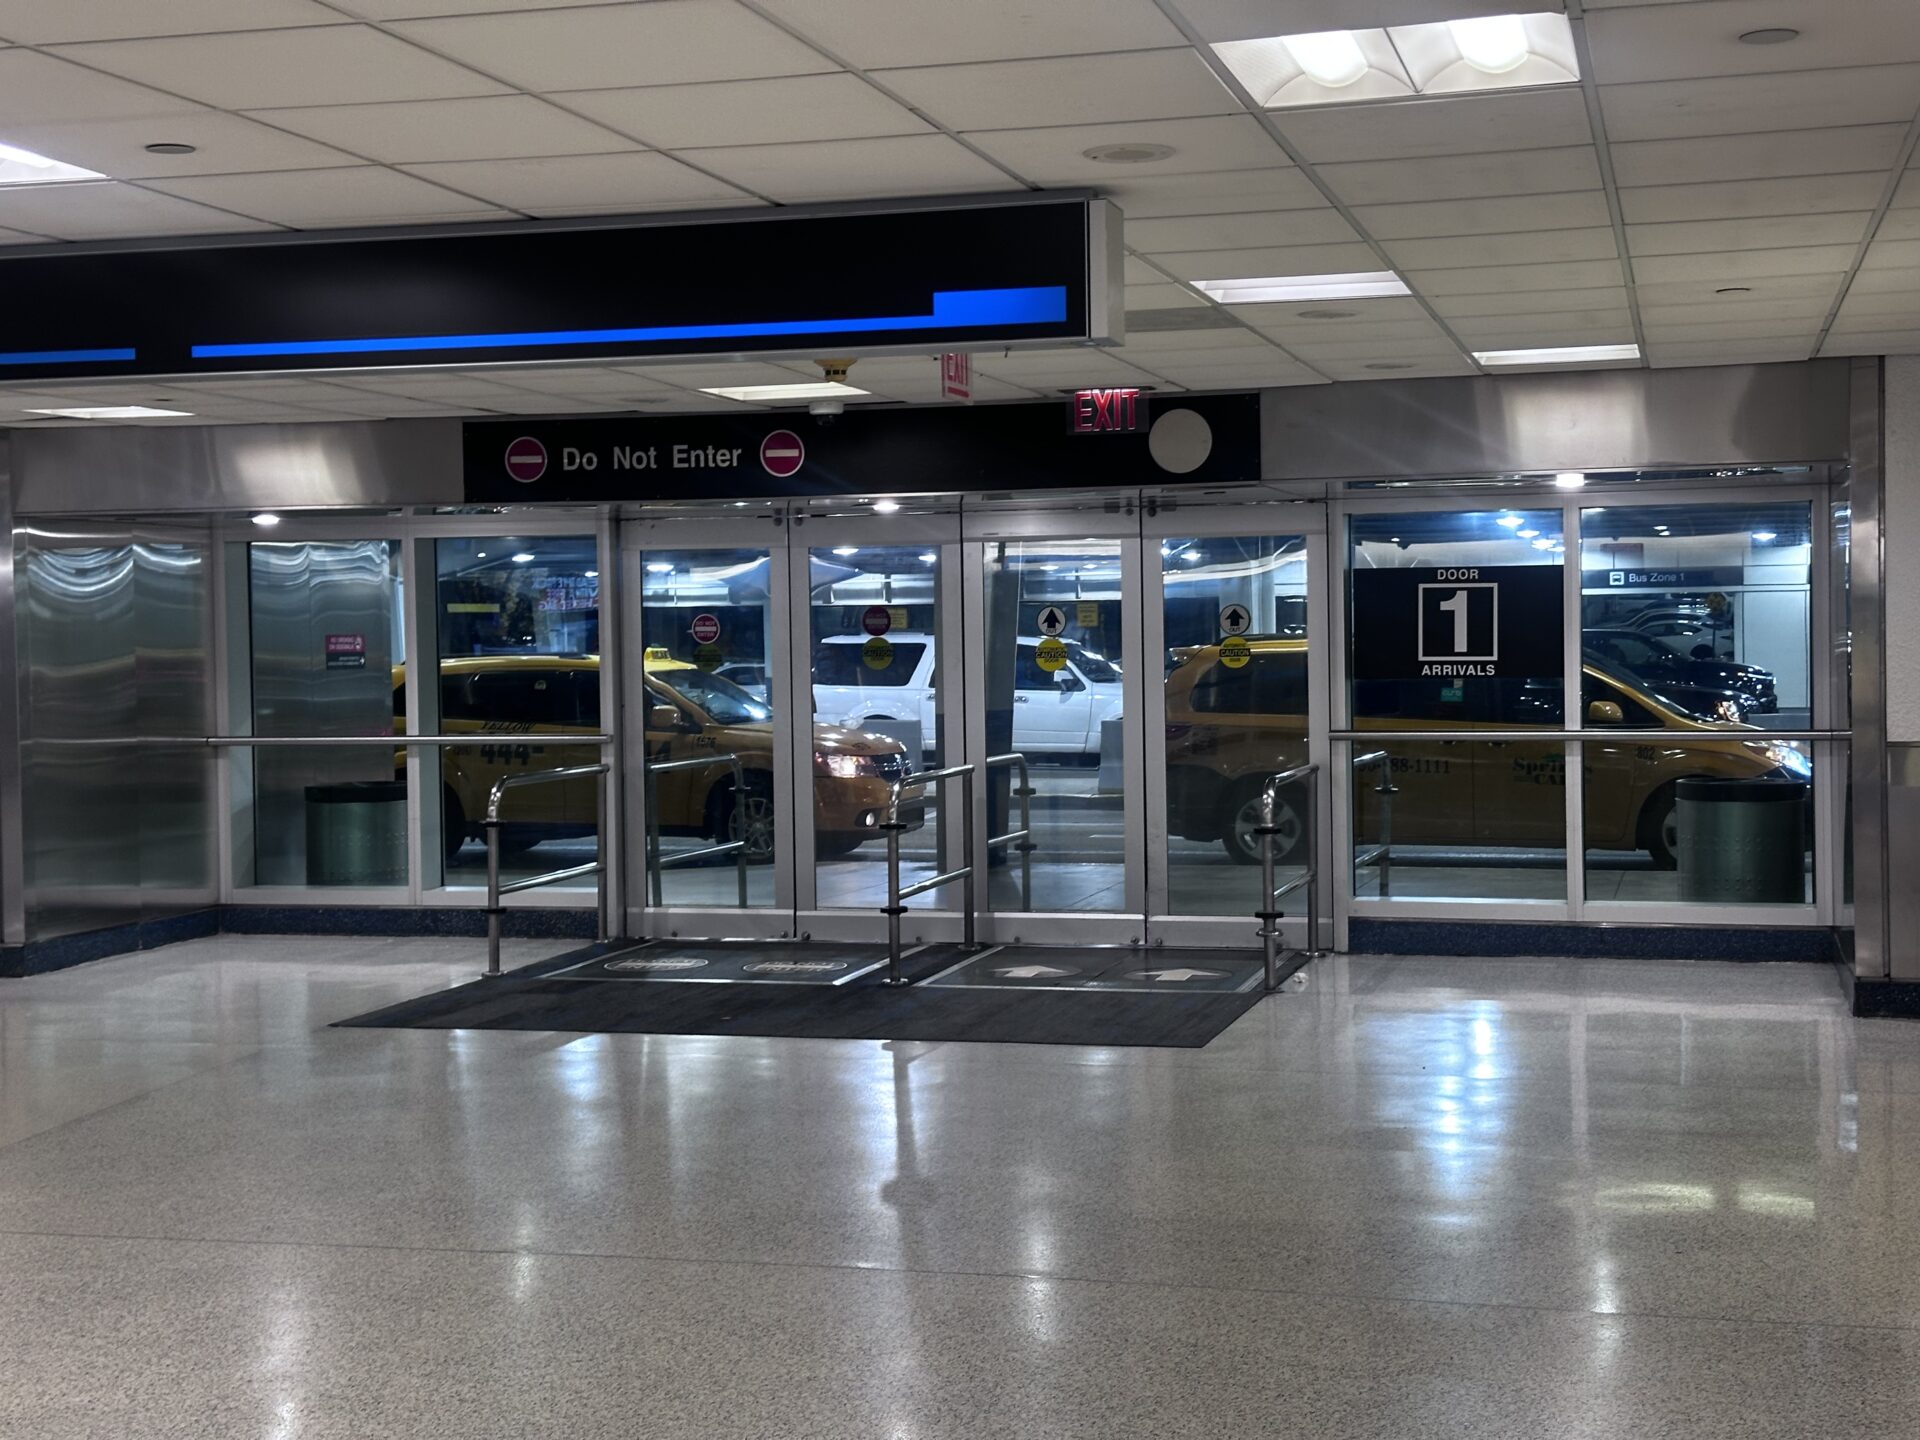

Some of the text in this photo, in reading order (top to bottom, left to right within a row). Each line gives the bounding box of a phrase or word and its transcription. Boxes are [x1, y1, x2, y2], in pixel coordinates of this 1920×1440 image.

[1073, 388, 1140, 432] EXIT
[562, 444, 742, 471] Do Not Enter
[1437, 569, 1479, 580] DOOR
[1628, 572, 1685, 583] Bus Zone 1
[1439, 590, 1468, 653] 1
[1219, 649, 1251, 657] CAUTION
[1421, 664, 1496, 676] ARRIVALS
